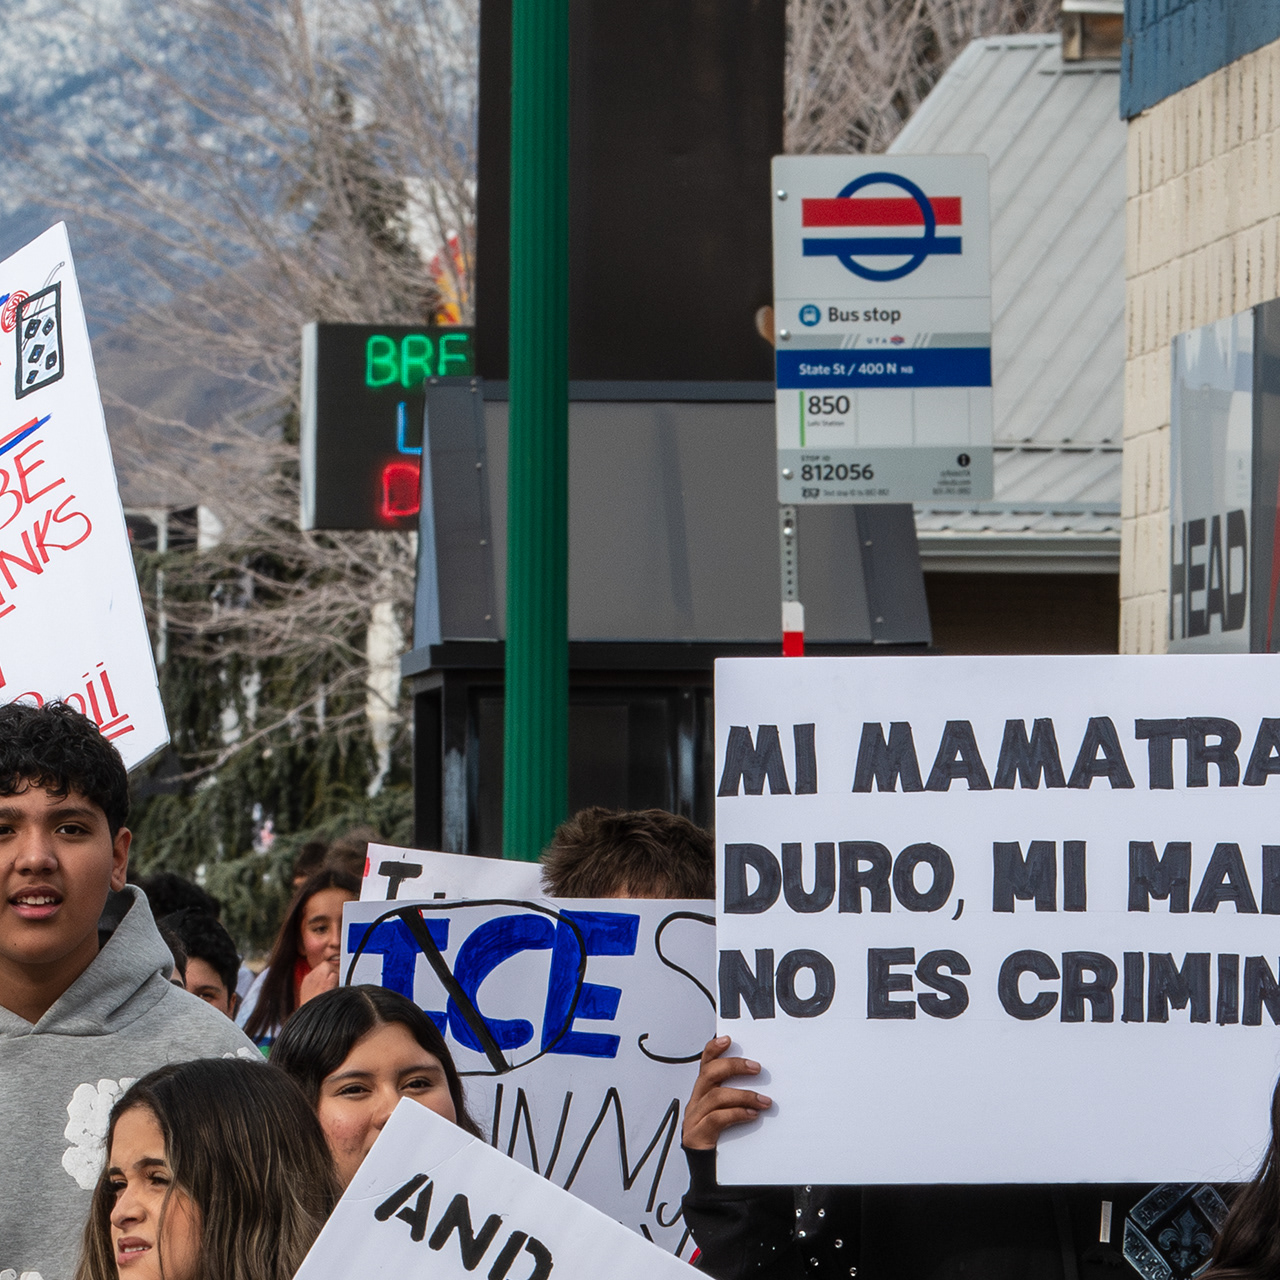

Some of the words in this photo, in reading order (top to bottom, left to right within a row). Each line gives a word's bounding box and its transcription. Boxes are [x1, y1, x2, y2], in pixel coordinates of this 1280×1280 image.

[828, 306, 860, 323] Bus
[863, 306, 902, 325] stop
[799, 363, 831, 376] State
[833, 363, 846, 376] St
[858, 362, 884, 376] 400
[886, 363, 898, 375] N
[808, 395, 850, 416] 850
[801, 463, 875, 482] 812056
[1170, 508, 1248, 642] HEAD
[716, 721, 819, 798] MI
[723, 839, 966, 922] DURO,
[992, 838, 1087, 914] MI
[347, 909, 641, 1059] ICE
[719, 947, 837, 1021] NO
[866, 946, 971, 1022] ES
